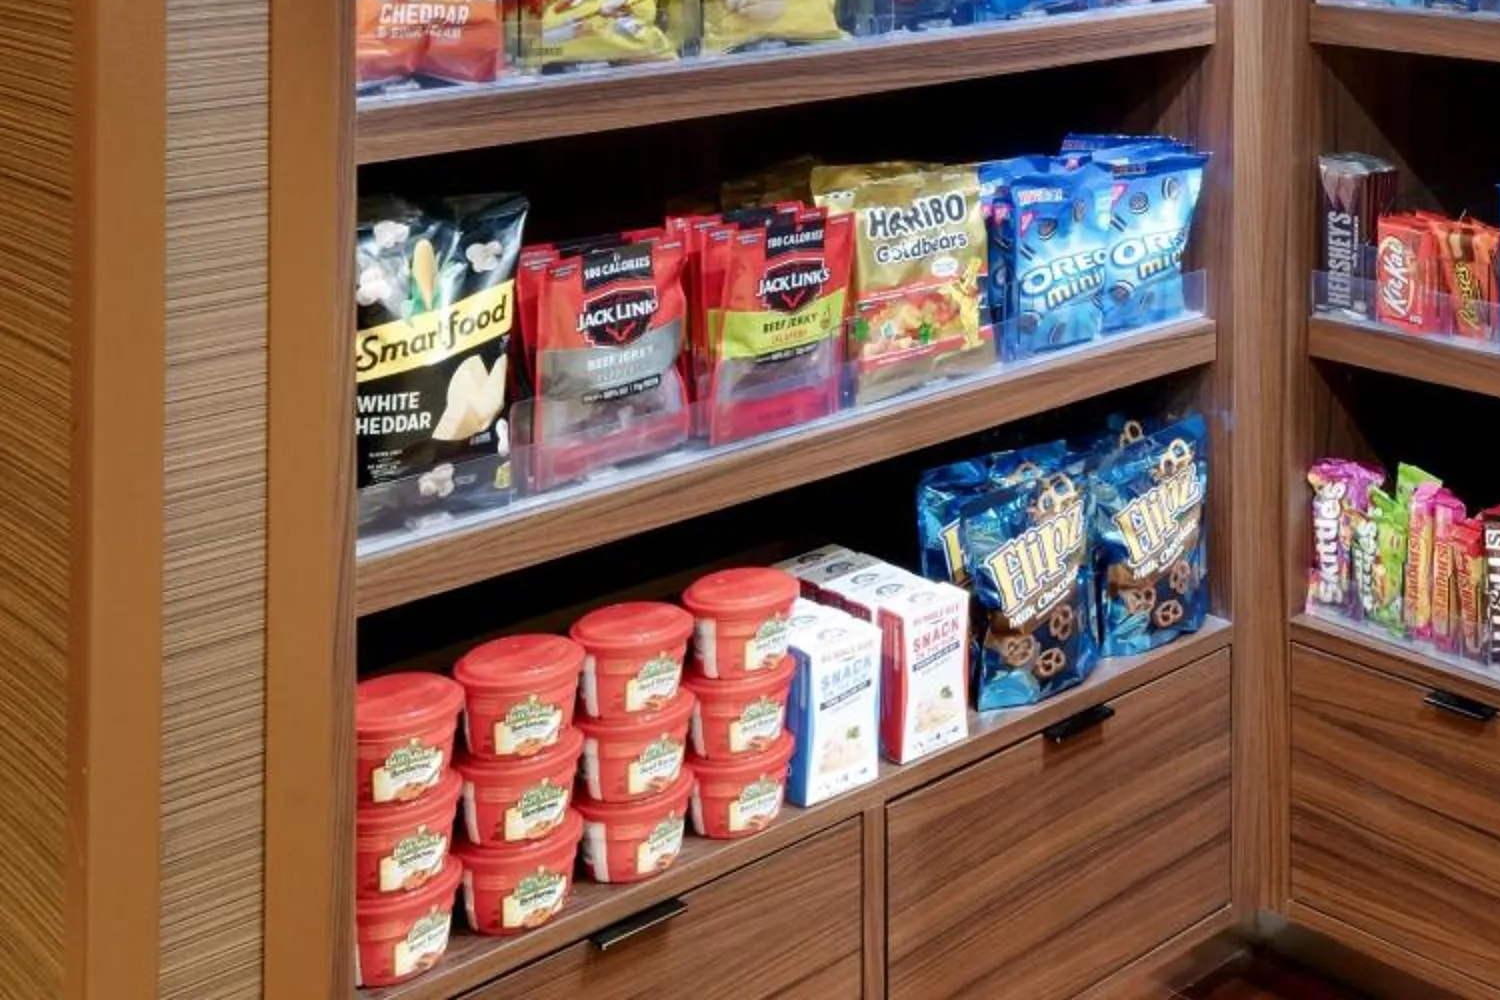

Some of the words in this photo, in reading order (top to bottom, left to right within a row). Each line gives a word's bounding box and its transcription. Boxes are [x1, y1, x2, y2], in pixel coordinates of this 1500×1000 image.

[379, 3, 470, 25] CHEDDAR
[869, 193, 965, 238] HARIBO
[783, 229, 824, 245] CALORIES
[876, 231, 968, 264] Goldbears
[602, 255, 651, 275] CALORIES
[1327, 210, 1352, 307] HERSHEY'S
[756, 275, 791, 297] JACK
[576, 308, 615, 332] JACK
[357, 391, 421, 413] WHITE
[356, 411, 431, 435] HEDDAR
[1116, 463, 1203, 567] Flipz
[1312, 480, 1348, 604] Skittles
[988, 500, 1084, 613] Flipz
[913, 617, 960, 653] SNACK
